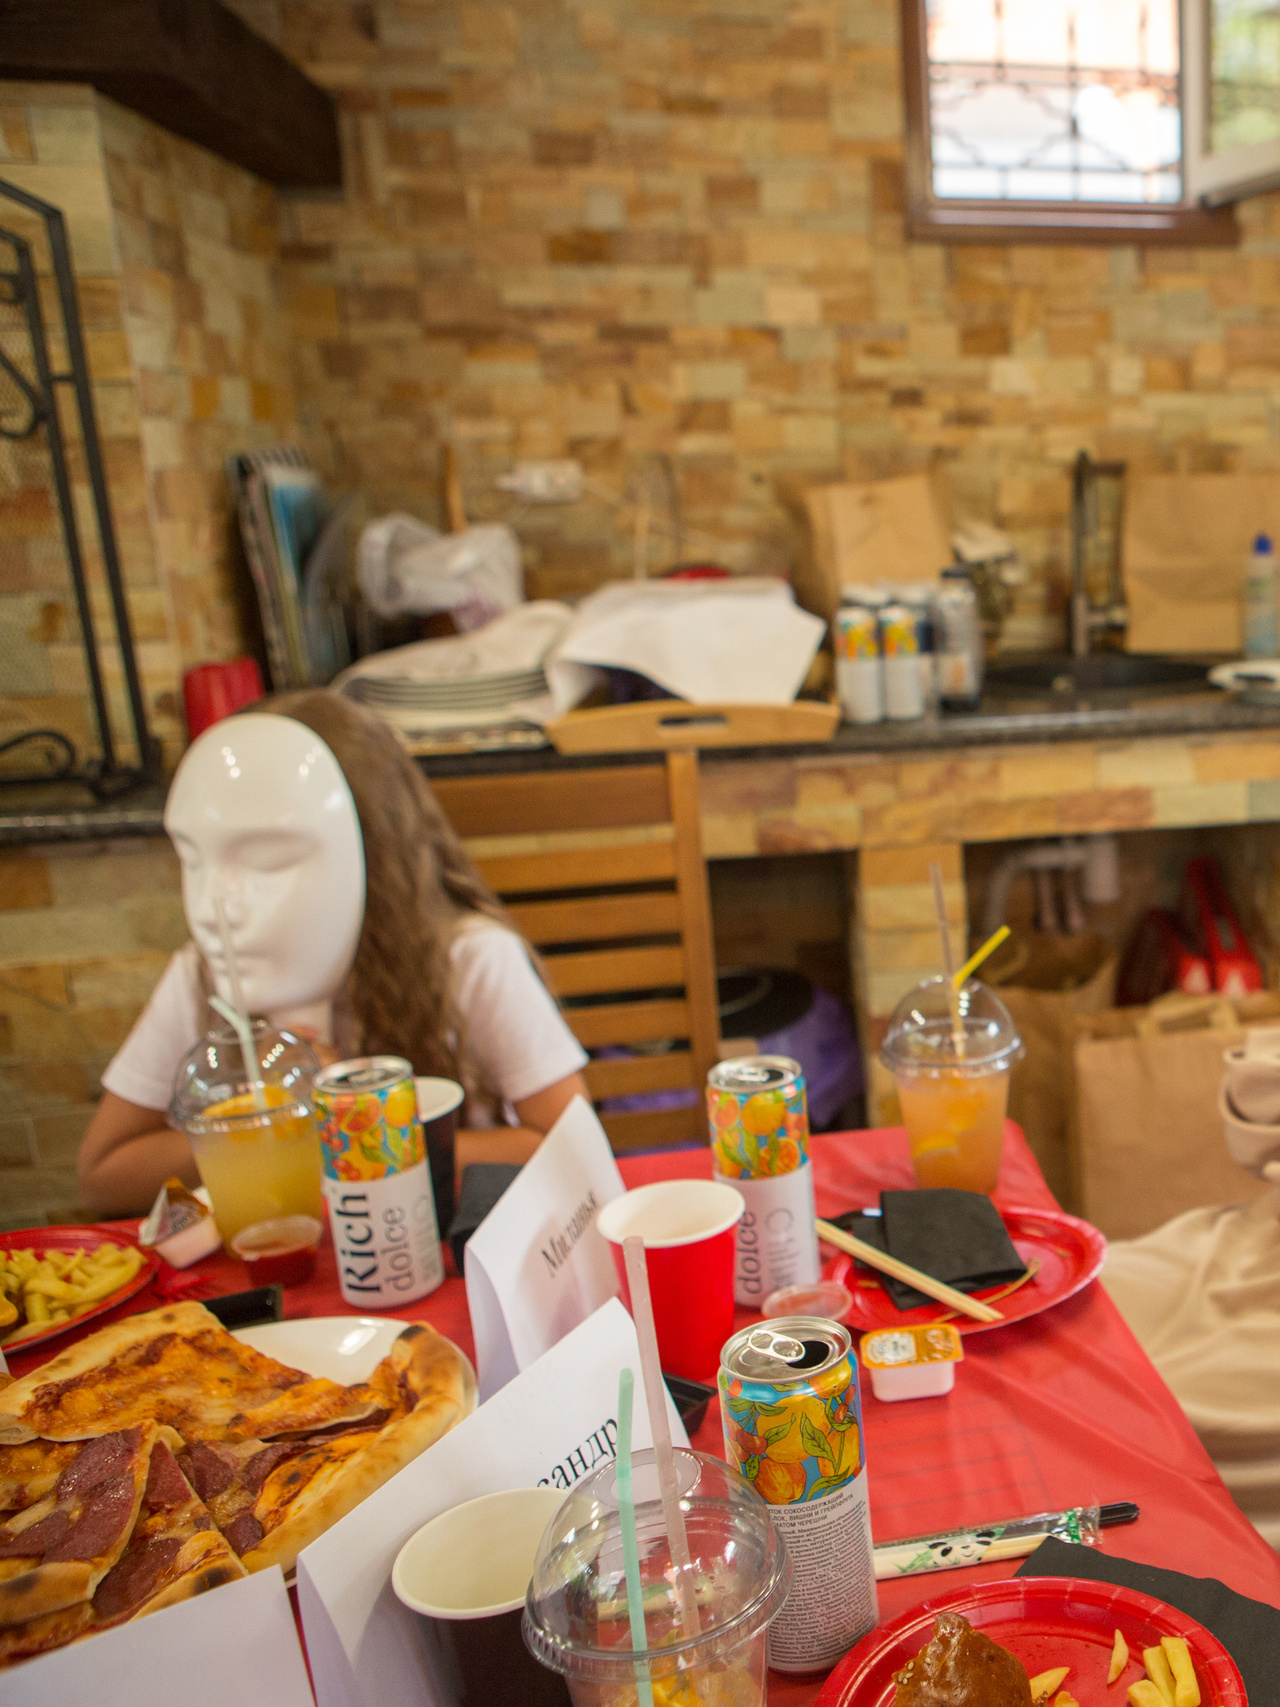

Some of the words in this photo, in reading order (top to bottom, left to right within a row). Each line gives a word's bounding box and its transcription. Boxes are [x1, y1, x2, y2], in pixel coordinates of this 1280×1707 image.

[334, 1193, 382, 1293] Rich
[380, 1205, 415, 1292] dolce
[737, 1210, 762, 1295] dolce
[789, 1512, 813, 1521] ВИШНИ
[820, 1494, 854, 1515] ГРЕЙПФРУТА
[797, 1515, 828, 1526] ЧЕРЕШНИ
